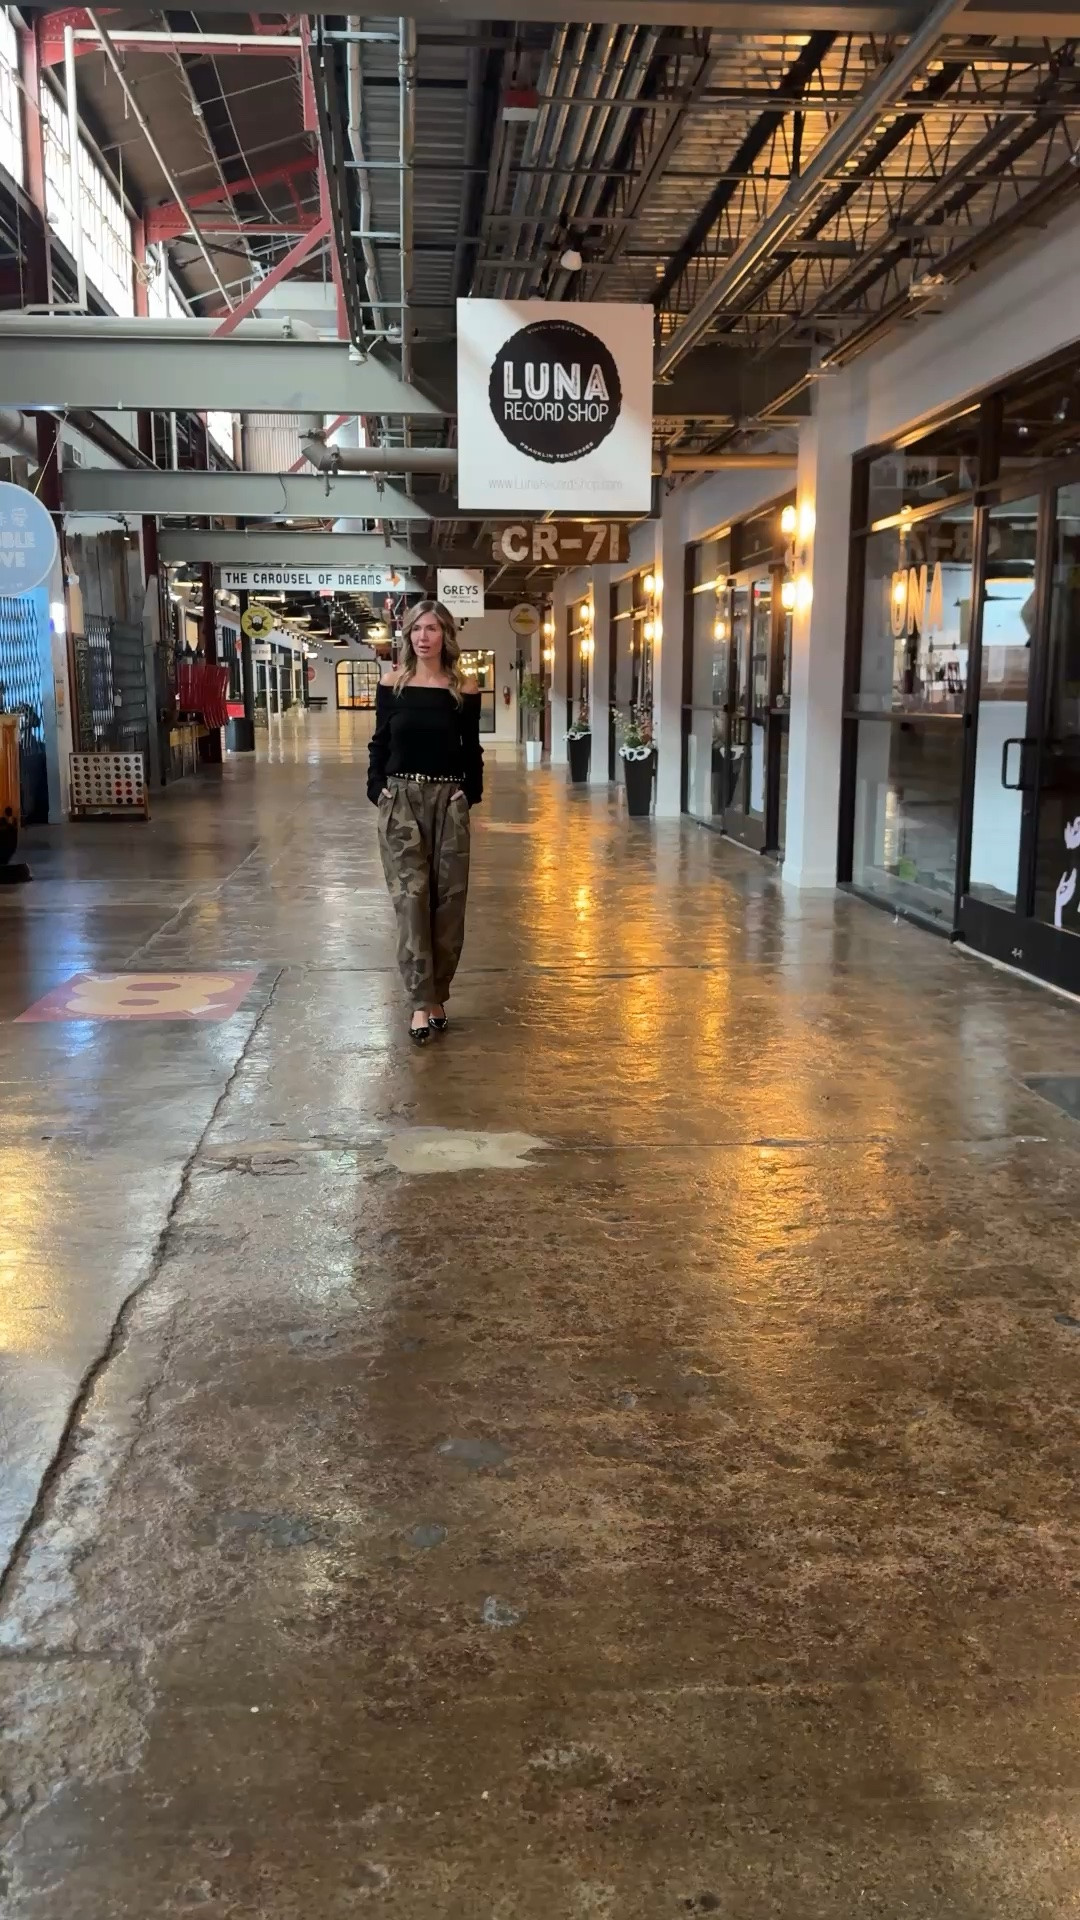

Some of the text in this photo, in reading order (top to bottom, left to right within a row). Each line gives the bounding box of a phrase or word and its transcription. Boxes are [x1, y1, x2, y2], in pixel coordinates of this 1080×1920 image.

[503, 361, 610, 401] LUNA
[504, 402, 609, 422] RECORD SHOP
[520, 441, 594, 459] FRANKLIN TENNESSEE
[0, 531, 36, 548] BLE
[501, 523, 620, 562] CR-71
[225, 572, 382, 585] THE CAROUSEL OF DREAMS
[443, 585, 479, 595] GREYS
[889, 561, 944, 636] UNA
